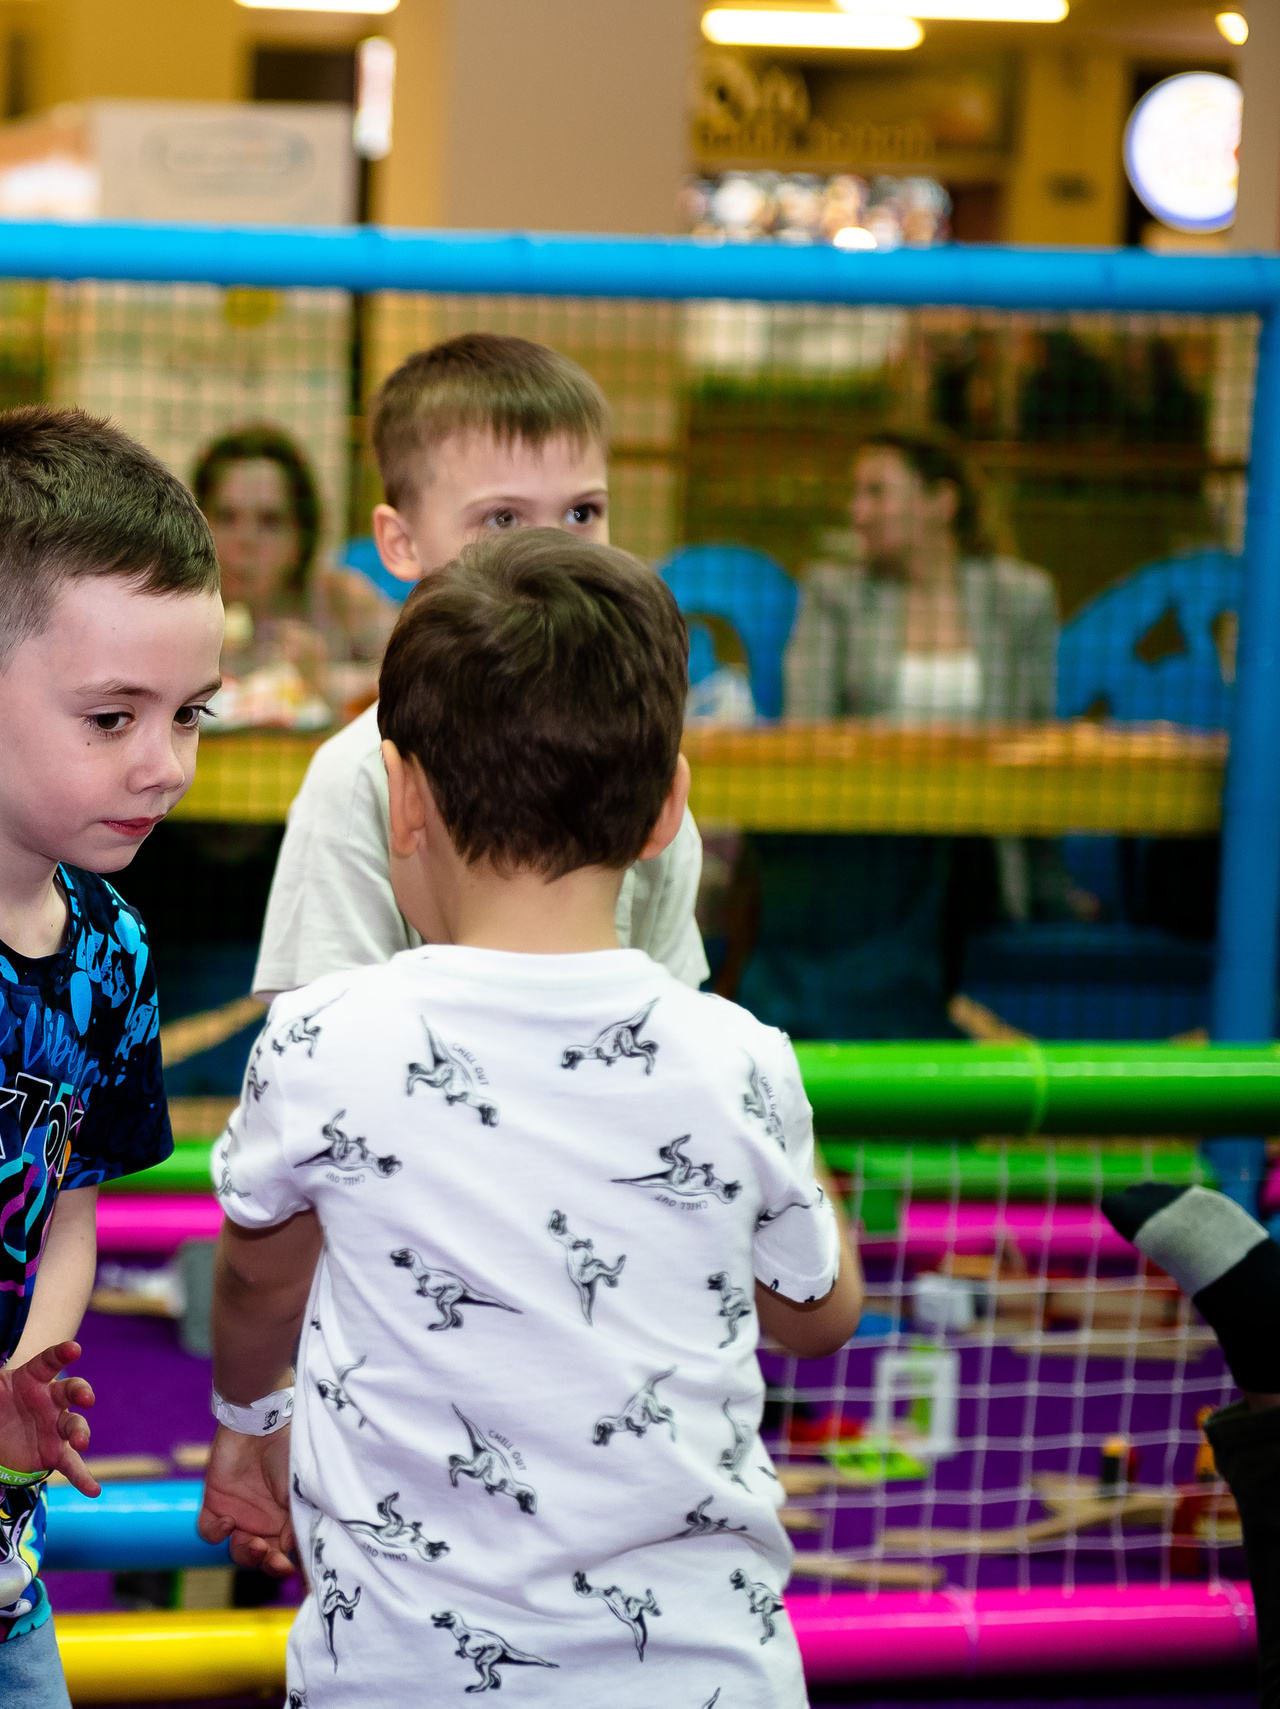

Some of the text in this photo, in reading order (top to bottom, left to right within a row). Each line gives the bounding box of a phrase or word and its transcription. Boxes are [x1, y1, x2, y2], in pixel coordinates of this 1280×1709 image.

[453, 1043, 489, 1086] CHILL OUT
[326, 1171, 366, 1186] CHILL OUT
[655, 1194, 708, 1211] CHILL OUT
[489, 1430, 527, 1471] CHILL OUT
[381, 1551, 408, 1562] CHILL
